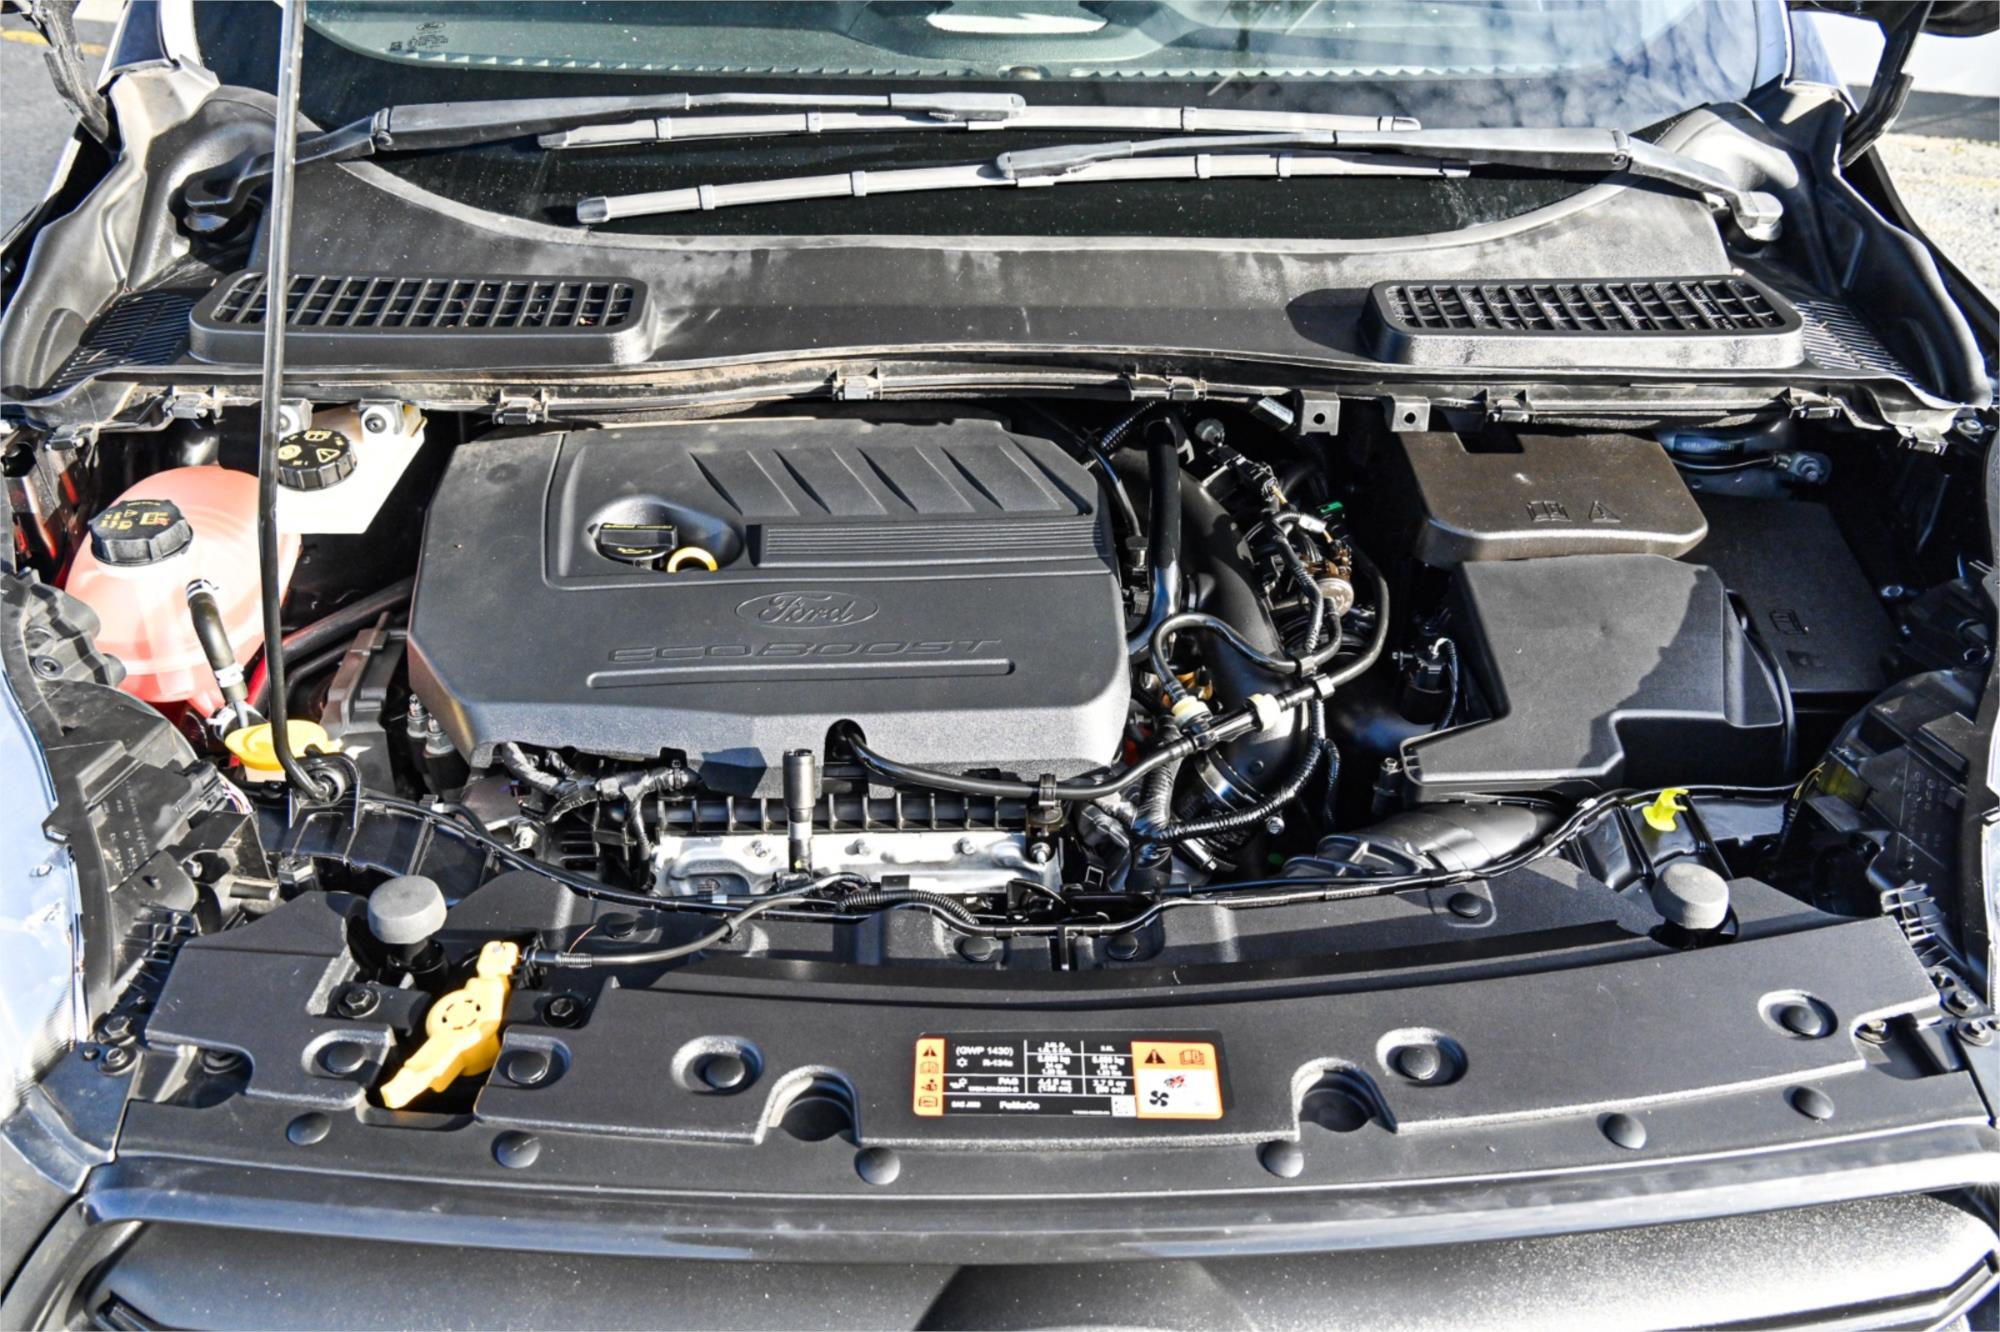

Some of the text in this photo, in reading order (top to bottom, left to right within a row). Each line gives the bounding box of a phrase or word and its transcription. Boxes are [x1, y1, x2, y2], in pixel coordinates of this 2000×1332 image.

[757, 594, 857, 624] Ford
[608, 639, 1002, 664] ECOBOOST
[956, 1046, 1014, 1057] (GWP 1430)
